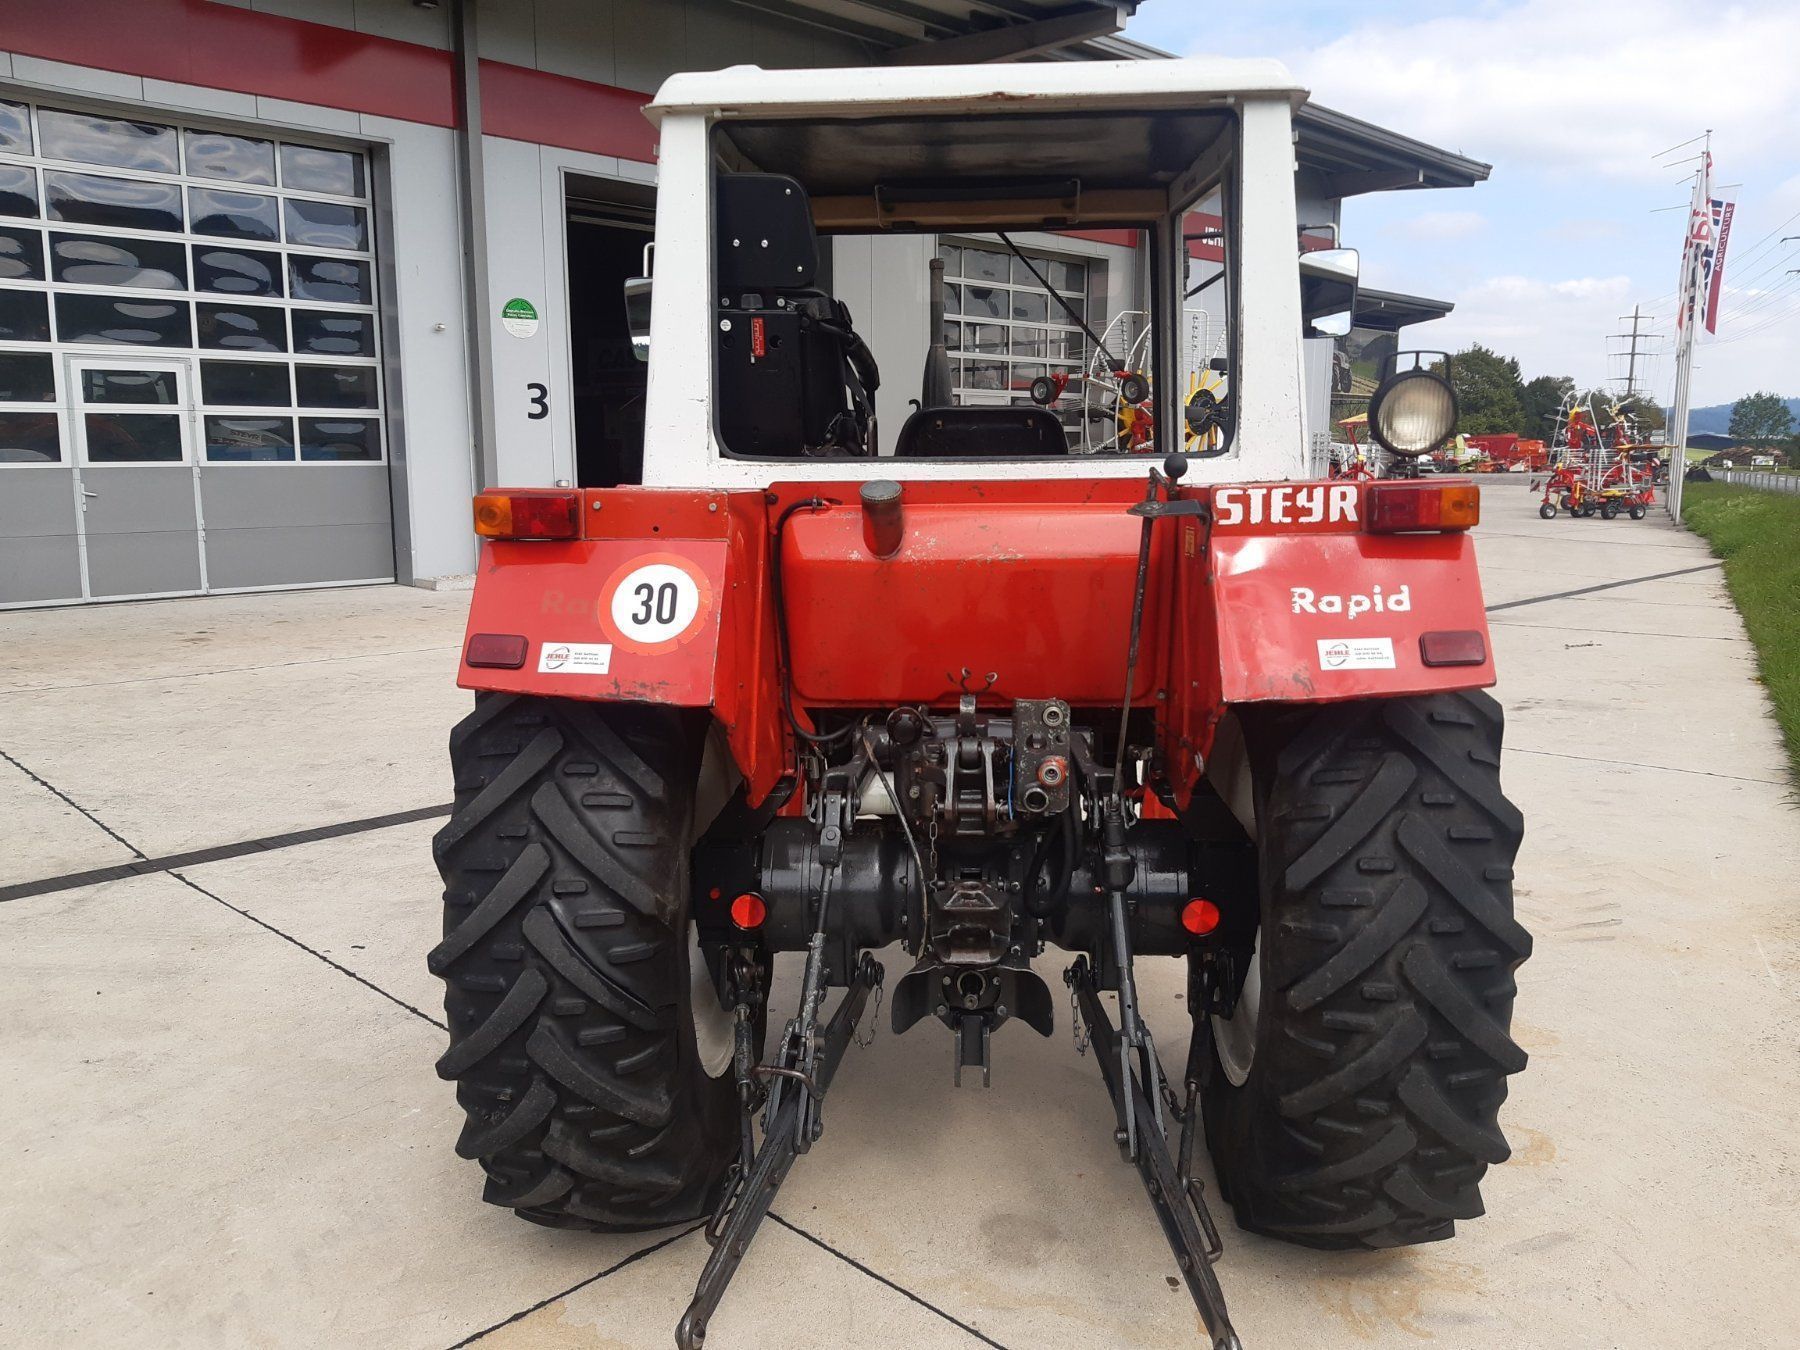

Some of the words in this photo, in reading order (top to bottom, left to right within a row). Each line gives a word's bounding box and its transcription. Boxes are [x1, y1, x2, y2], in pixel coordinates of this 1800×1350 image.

[1714, 205, 1735, 272] AGRICULTURE
[527, 383, 549, 420] 3
[1215, 485, 1358, 526] STEYR
[631, 582, 678, 626] 30
[1290, 584, 1411, 620] Rapid
